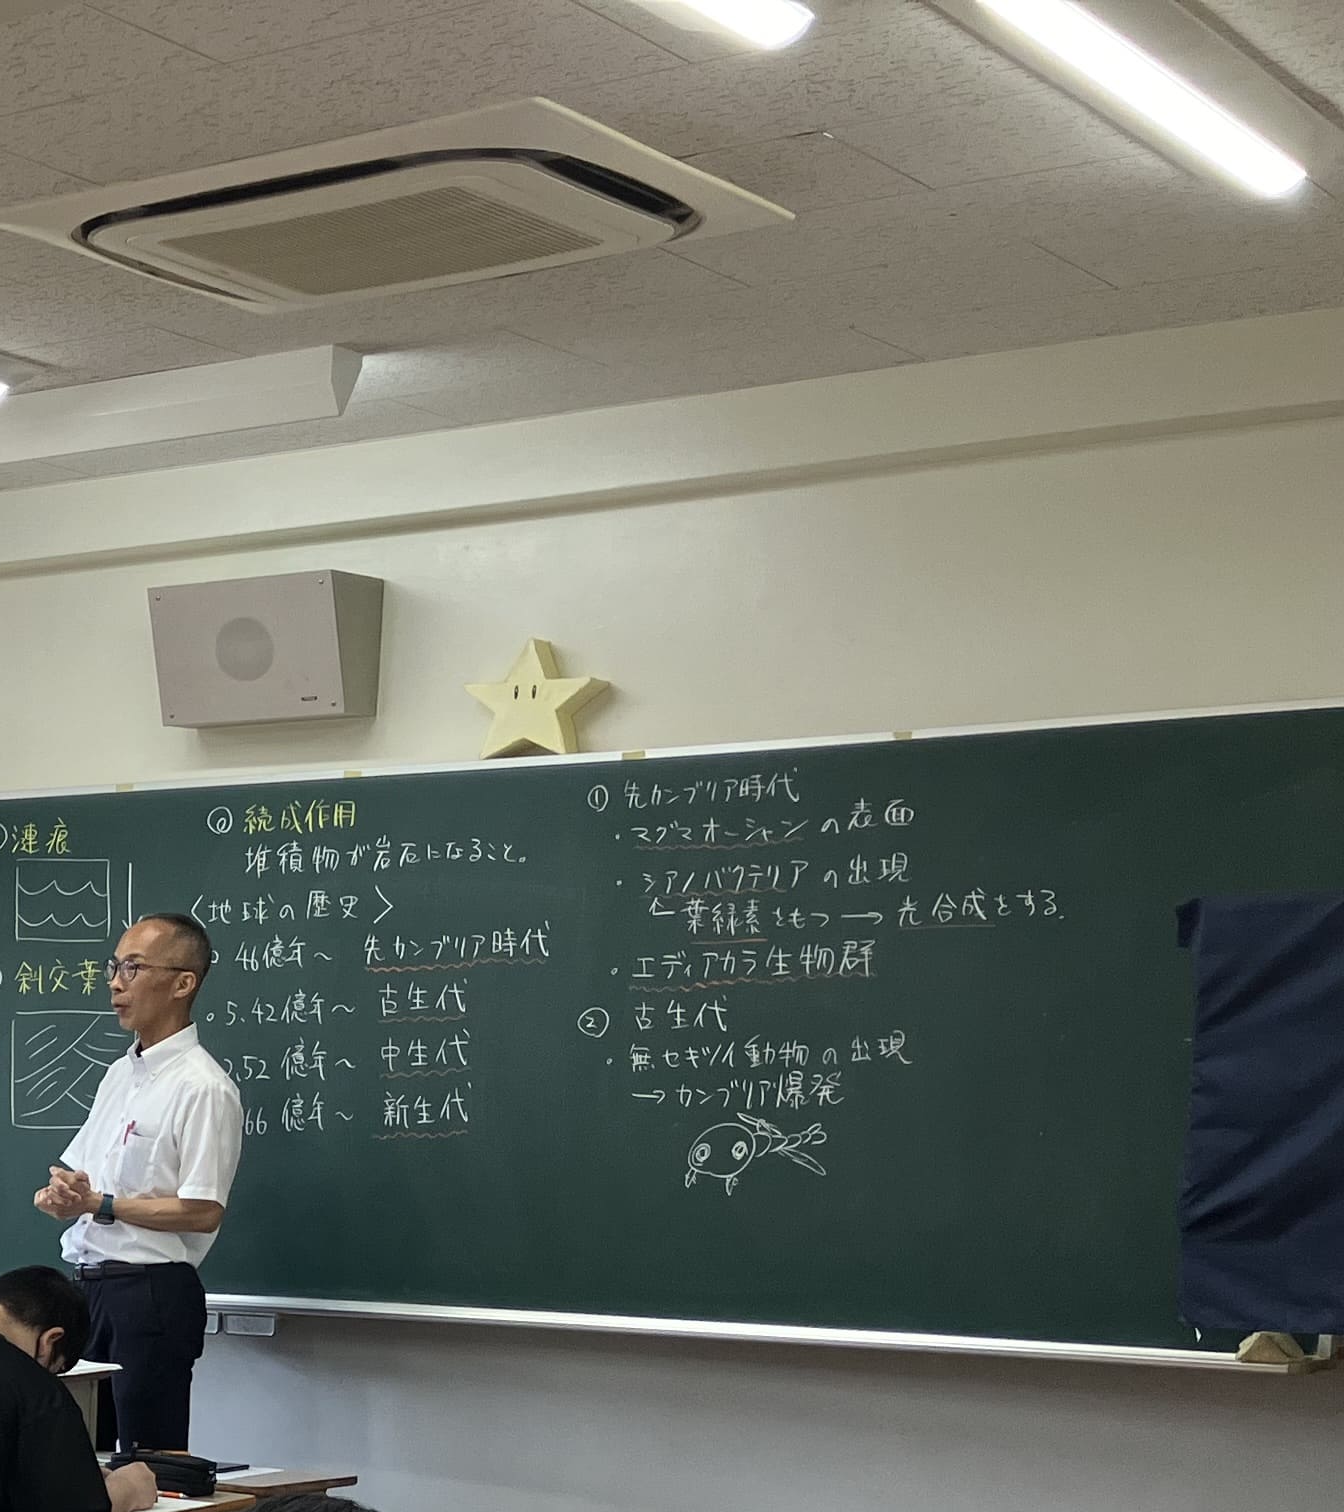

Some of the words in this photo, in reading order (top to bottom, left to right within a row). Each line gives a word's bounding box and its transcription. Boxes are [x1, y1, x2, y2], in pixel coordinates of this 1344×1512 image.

[624, 767, 800, 809] 先カンブリア時代
[243, 800, 357, 835] 続成作用
[364, 920, 552, 963] 先カンブリア時代
[631, 940, 875, 979] エディアカラ生物群
[378, 978, 469, 1016] 古生代
[633, 995, 728, 1032] 古生代
[380, 1028, 471, 1072] 中生代
[383, 1080, 472, 1129] 新生代
[675, 1070, 845, 1110] カンブリア爆発
